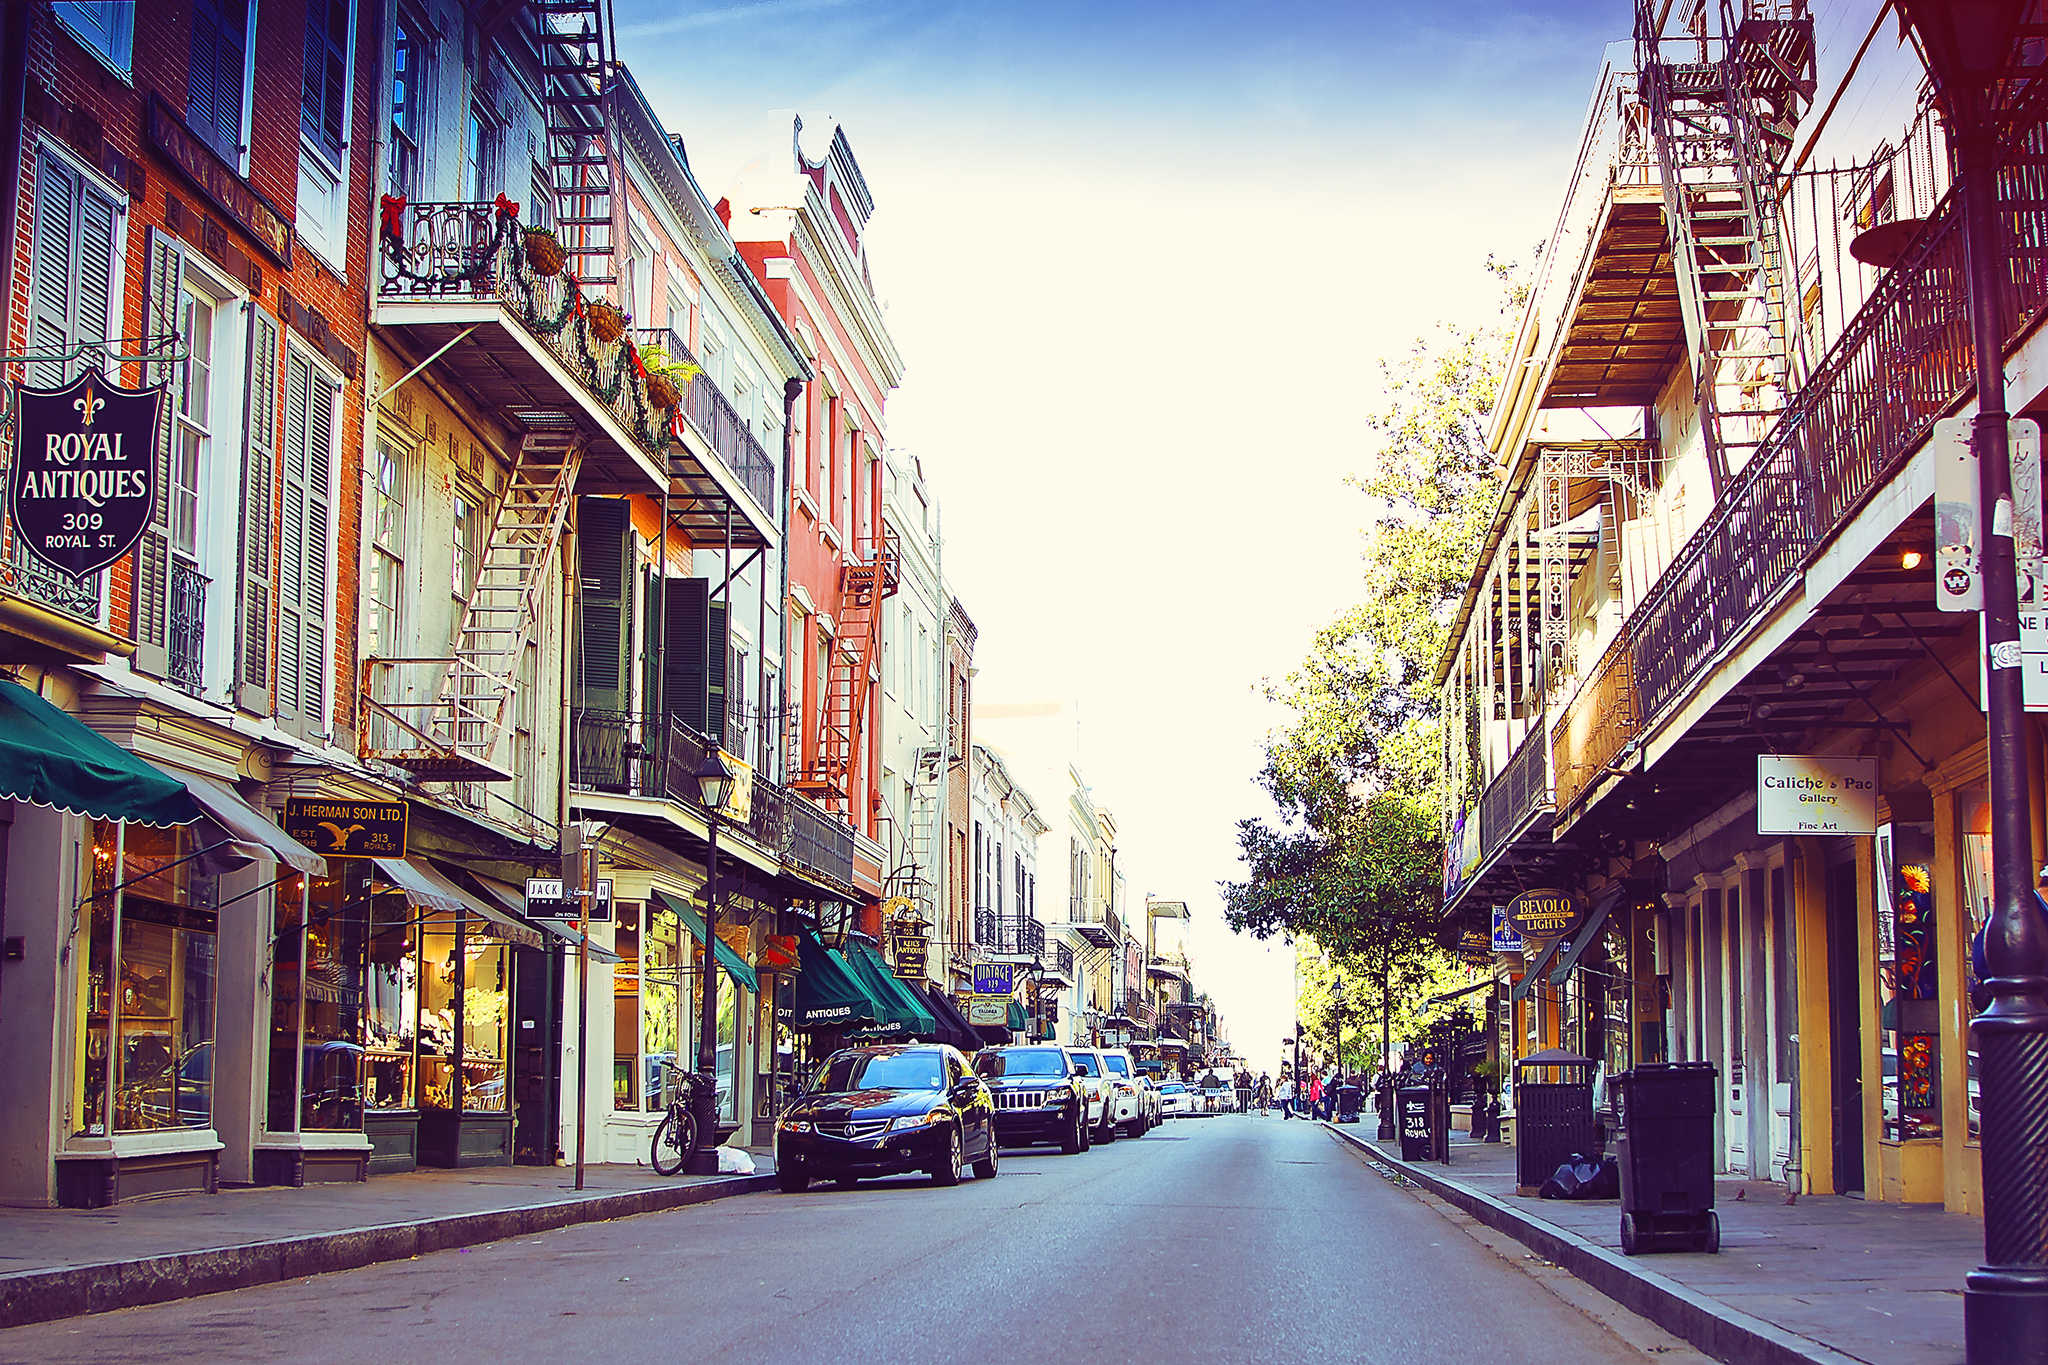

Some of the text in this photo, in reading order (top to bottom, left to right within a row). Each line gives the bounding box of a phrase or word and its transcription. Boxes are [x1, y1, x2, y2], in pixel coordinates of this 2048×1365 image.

[45, 433, 127, 466] ROYAL
[21, 470, 146, 507] ANTIQUES
[62, 513, 103, 530] 309
[46, 535, 117, 548] ROYAL ST.
[1764, 776, 1824, 790] Caliche
[1844, 777, 1873, 789] Pao
[1798, 793, 1838, 804] Gallery
[289, 804, 403, 822] J. HERMAN SON LTD.
[1798, 822, 1837, 830] Fine Art
[292, 829, 318, 838] EST.
[371, 833, 389, 843] 313
[364, 842, 396, 851] ROYAL ST
[531, 883, 558, 895] JACK
[1519, 898, 1571, 914] BEVOLO
[1527, 918, 1567, 931] LIGHTS
[898, 946, 925, 954] ANTIQUES
[977, 965, 1010, 982] VINTAGE
[987, 980, 999, 988] 329
[805, 1007, 851, 1019] ANTIQUES
[1405, 1117, 1425, 1129] 318
